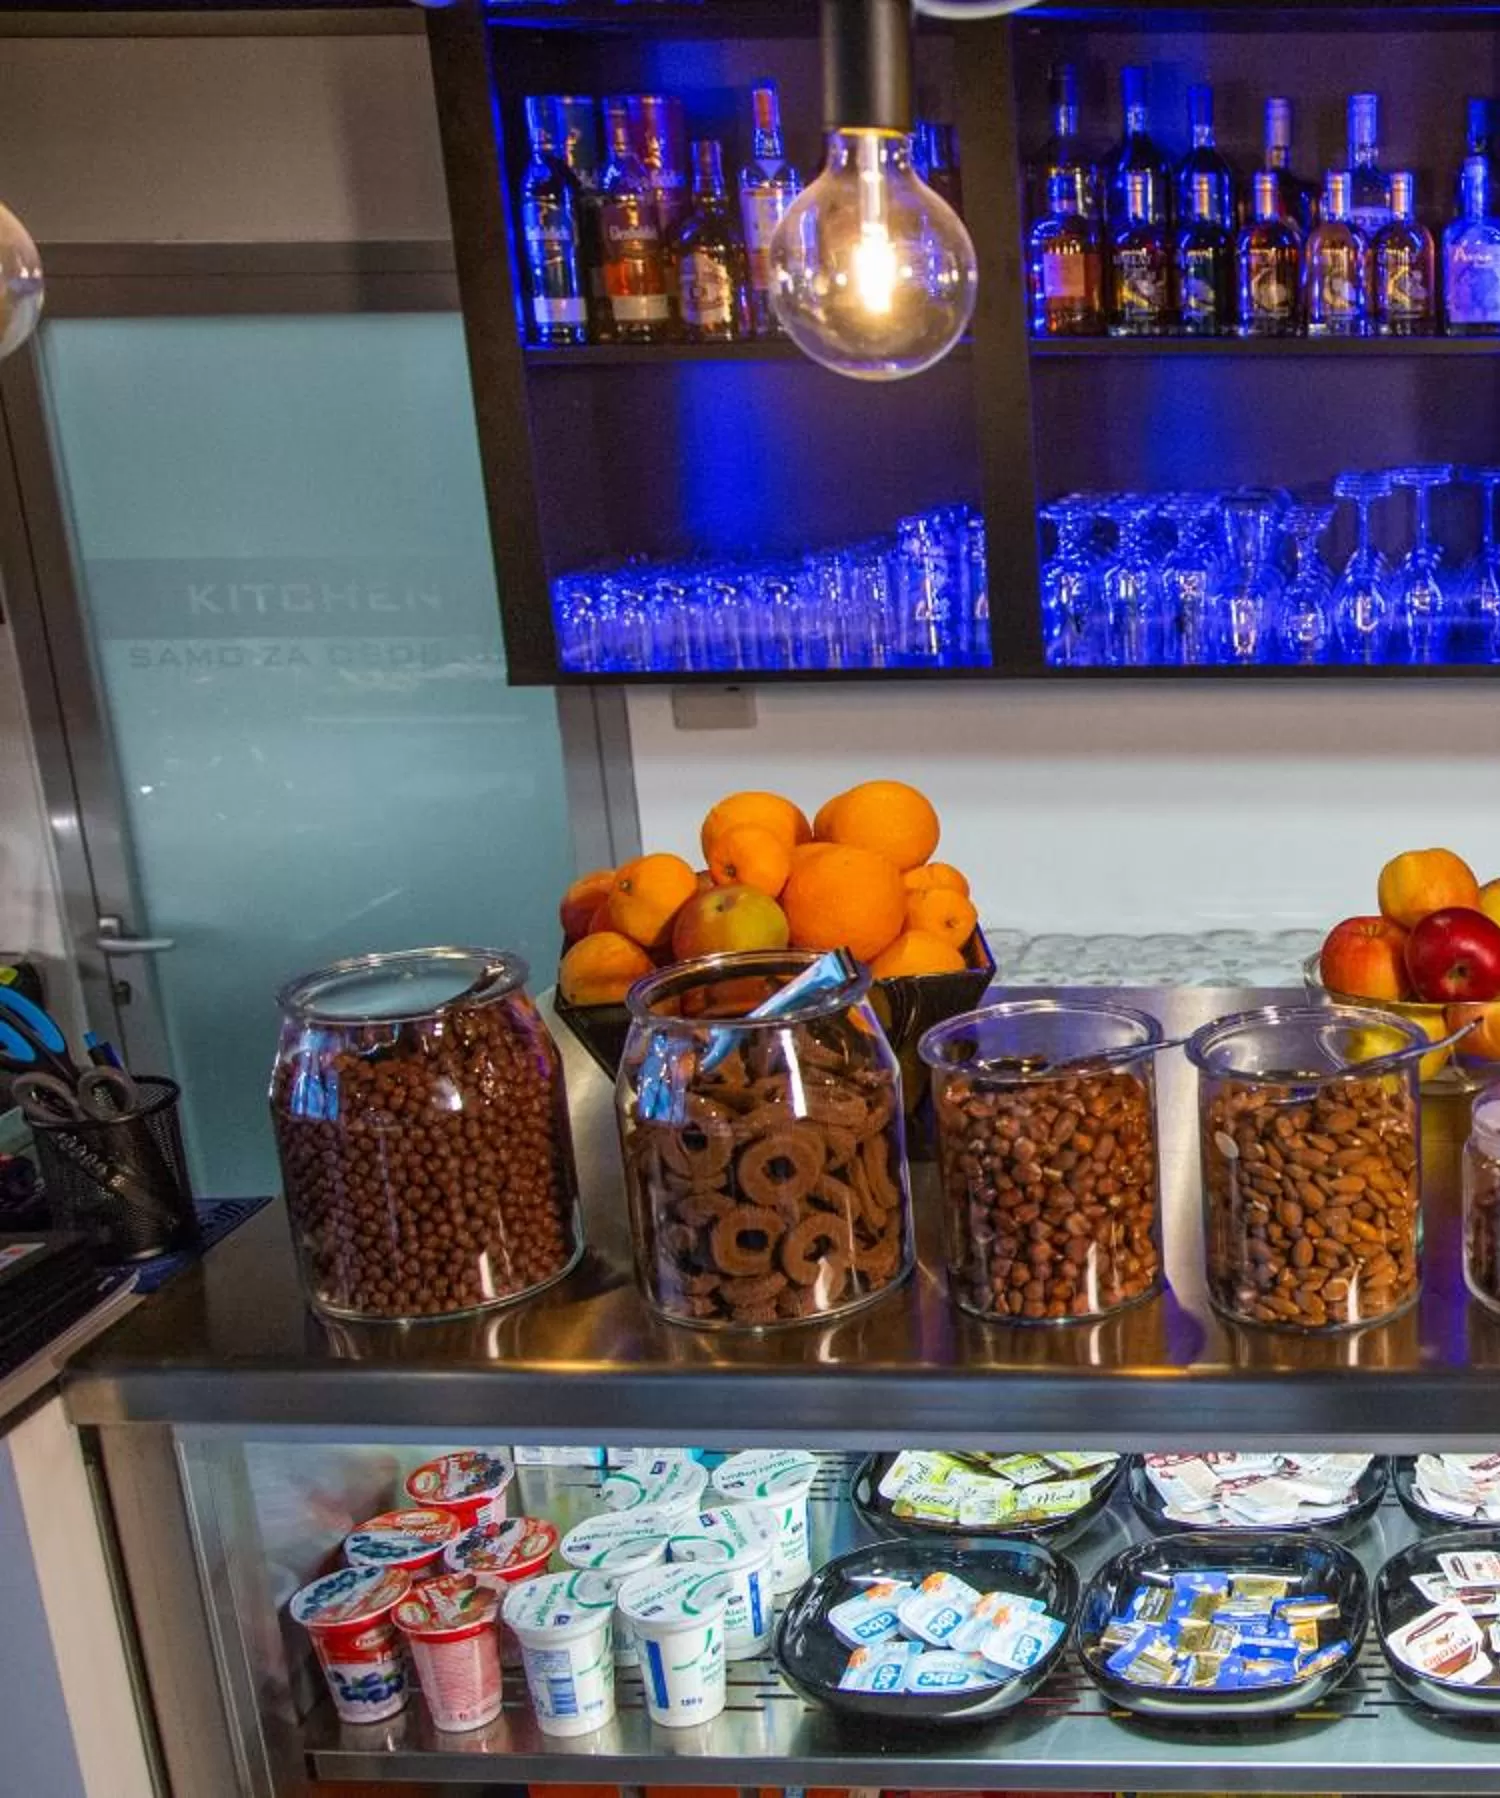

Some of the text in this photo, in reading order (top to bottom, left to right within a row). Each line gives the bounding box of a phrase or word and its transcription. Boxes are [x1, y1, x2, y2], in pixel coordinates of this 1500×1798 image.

[188, 582, 443, 615] KITCHEN
[128, 645, 246, 670] SAMO
[262, 644, 311, 668] ZA
[857, 1612, 893, 1637] abc
